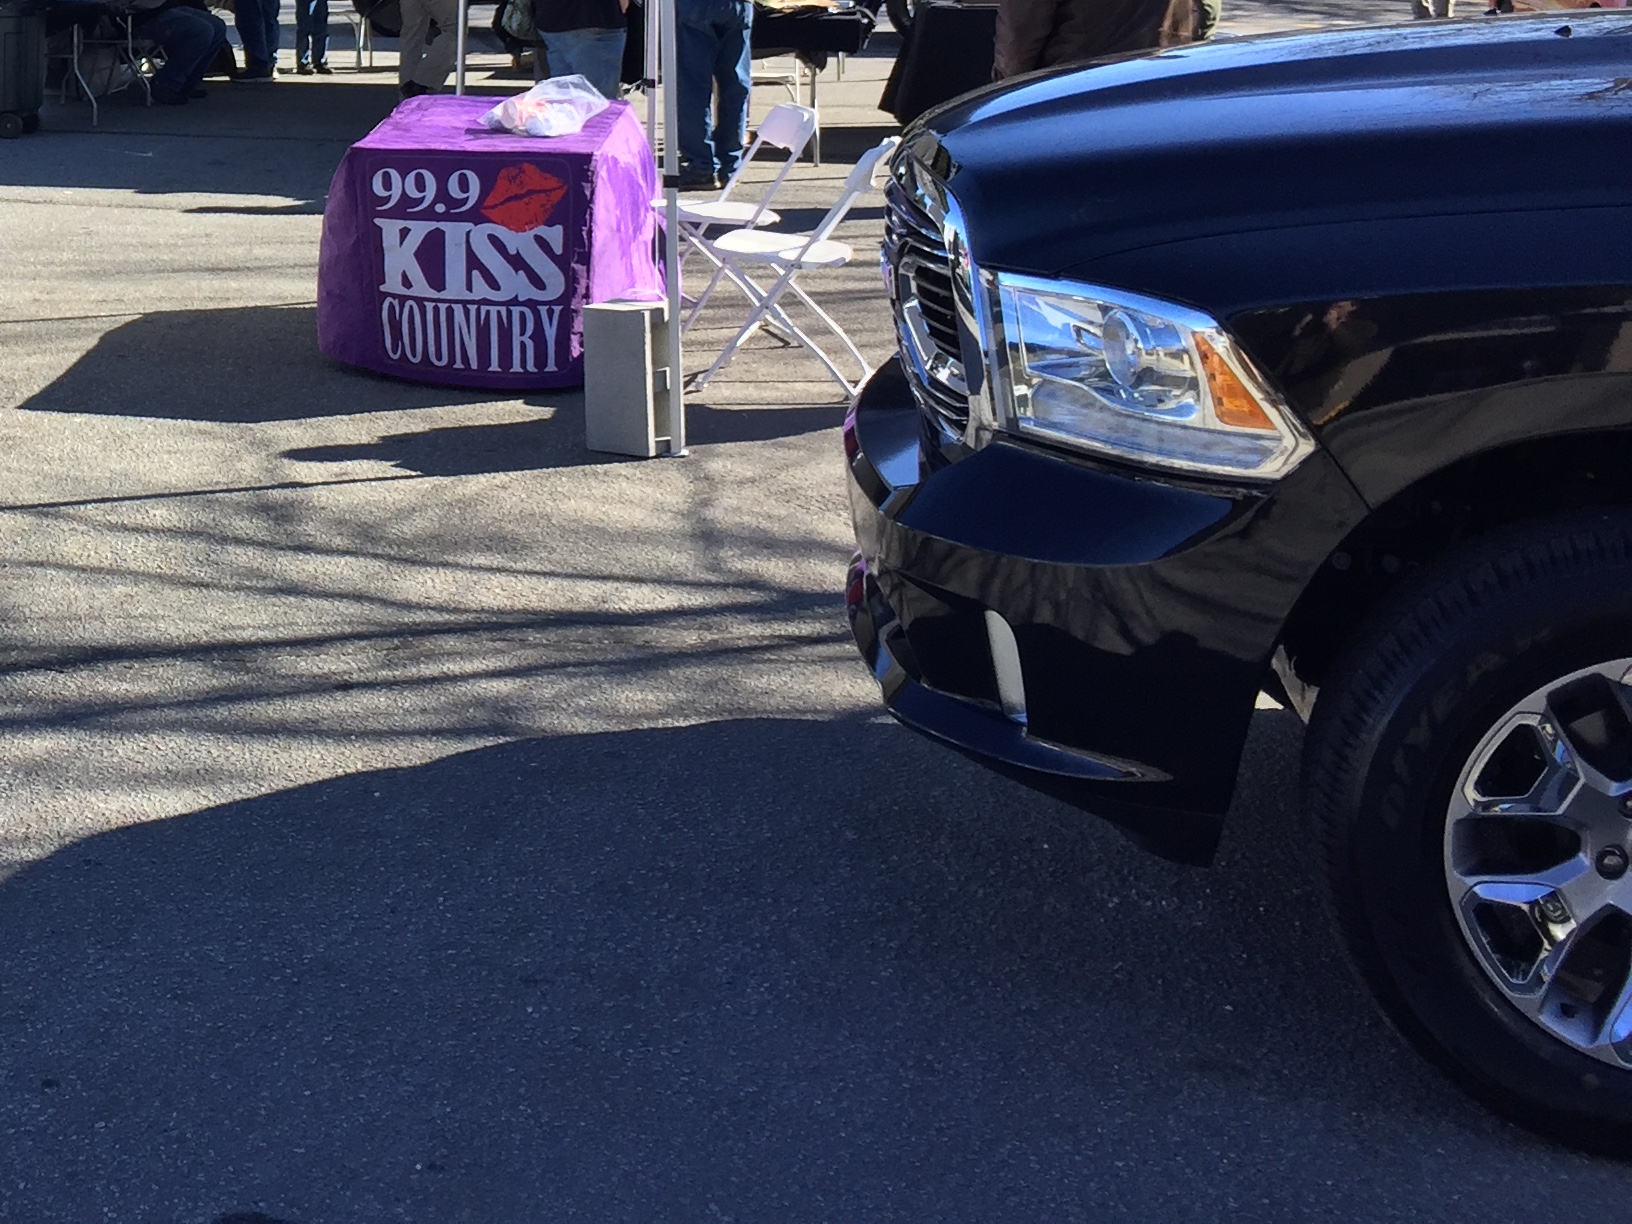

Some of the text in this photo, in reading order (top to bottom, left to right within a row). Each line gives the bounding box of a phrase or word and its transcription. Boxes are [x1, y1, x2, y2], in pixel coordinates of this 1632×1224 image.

[371, 167, 481, 213] 99.9
[373, 217, 565, 303] KISS
[381, 296, 563, 373] COUNTRY
